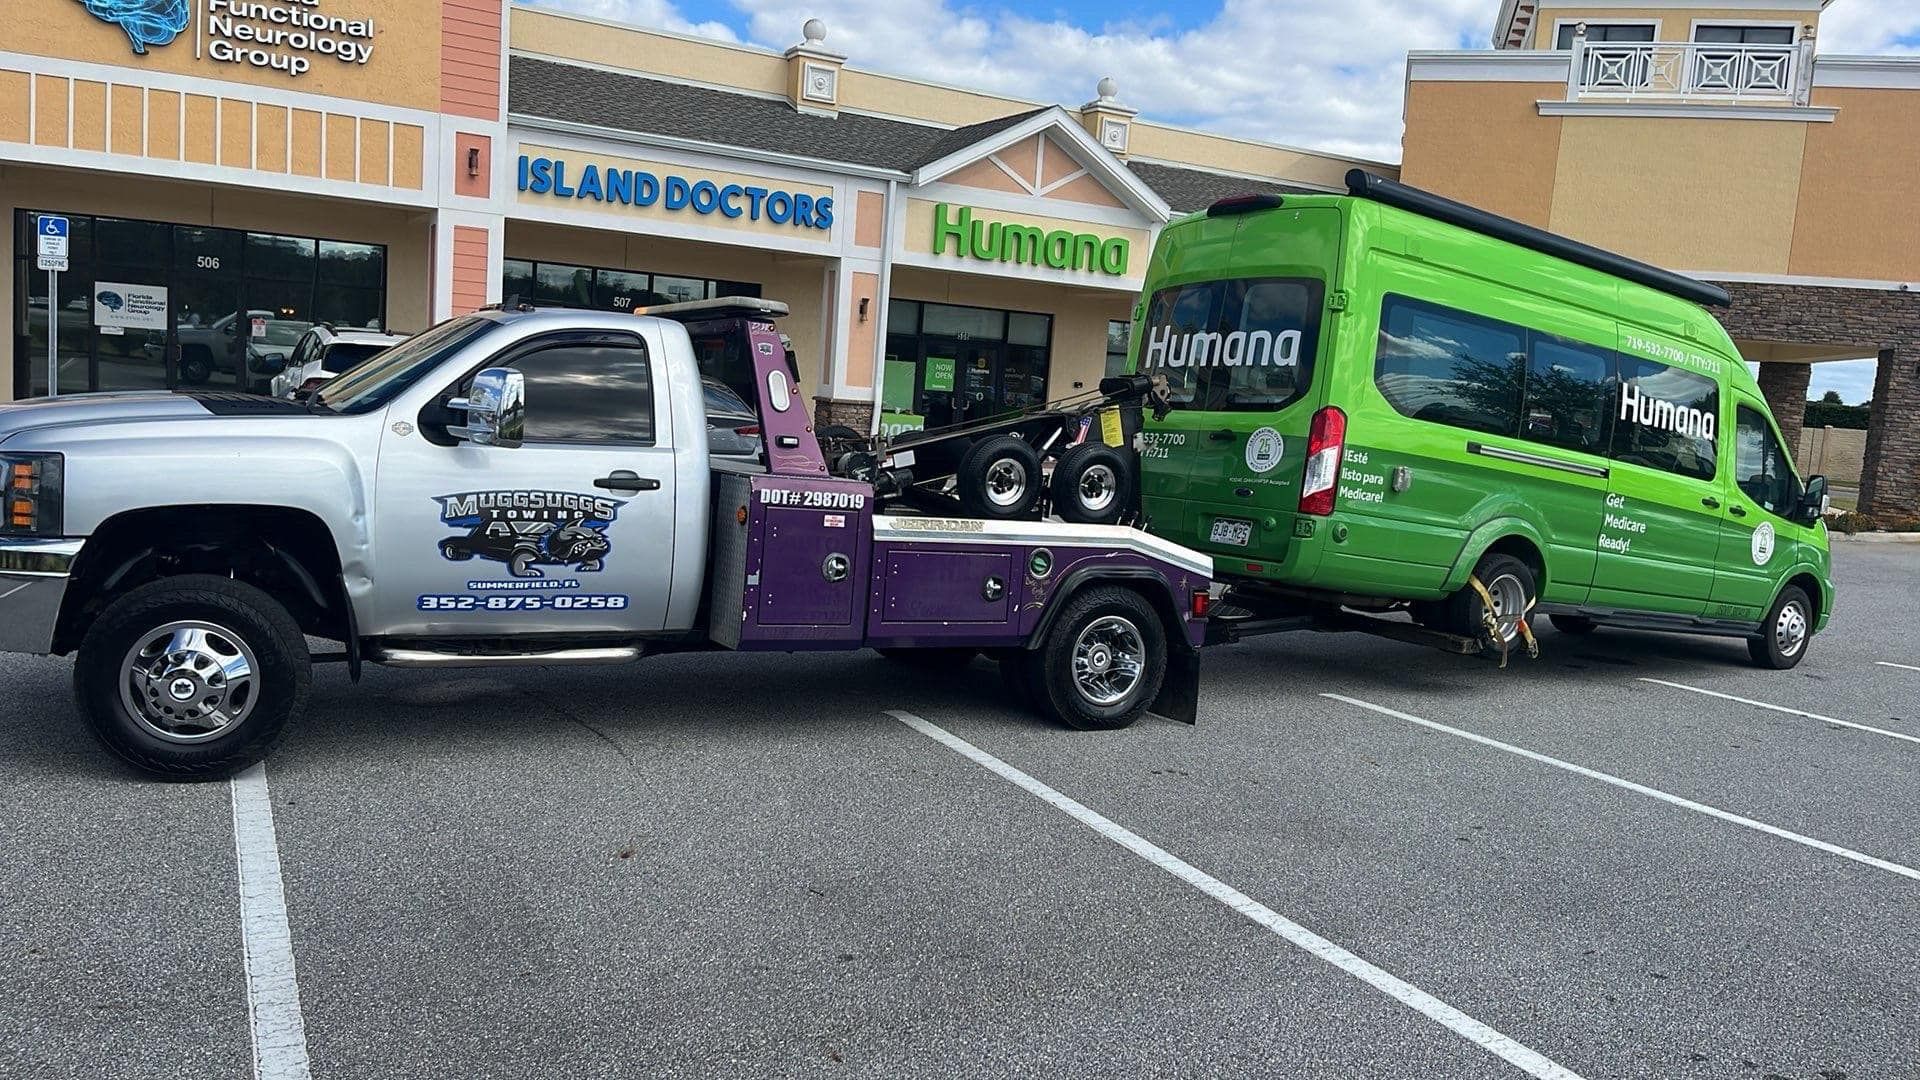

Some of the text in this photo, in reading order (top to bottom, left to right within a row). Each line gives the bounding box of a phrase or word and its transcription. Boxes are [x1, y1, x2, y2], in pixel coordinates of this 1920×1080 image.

[209, 0, 374, 38] Functional
[209, 15, 374, 64] Neurology
[209, 39, 311, 76] Group
[518, 155, 834, 230] ISLAND DOCTORS
[933, 202, 1130, 276] Humana
[197, 256, 220, 269] 506
[613, 296, 631, 308] 507
[1145, 325, 1302, 368] Humana
[1626, 335, 1684, 363] 719-532-7700
[1691, 354, 1721, 375] TTY:711
[935, 363, 953, 371] NOW
[935, 371, 953, 380] OPEN
[1620, 382, 1715, 441] Humana
[1143, 432, 1186, 445] 532-7700
[1341, 467, 1384, 485] listo para
[760, 488, 865, 509] DOT# 2987019
[1339, 485, 1384, 503] Medicare!
[1606, 493, 1625, 509] Get
[444, 491, 618, 520] MUGGSUGGS
[490, 509, 585, 519] TOWING
[1604, 513, 1647, 534] Medicare
[1599, 533, 1631, 554] Ready!
[469, 580, 579, 589] SUMMERFIELD, FL
[422, 596, 625, 609] 352-875-0258
